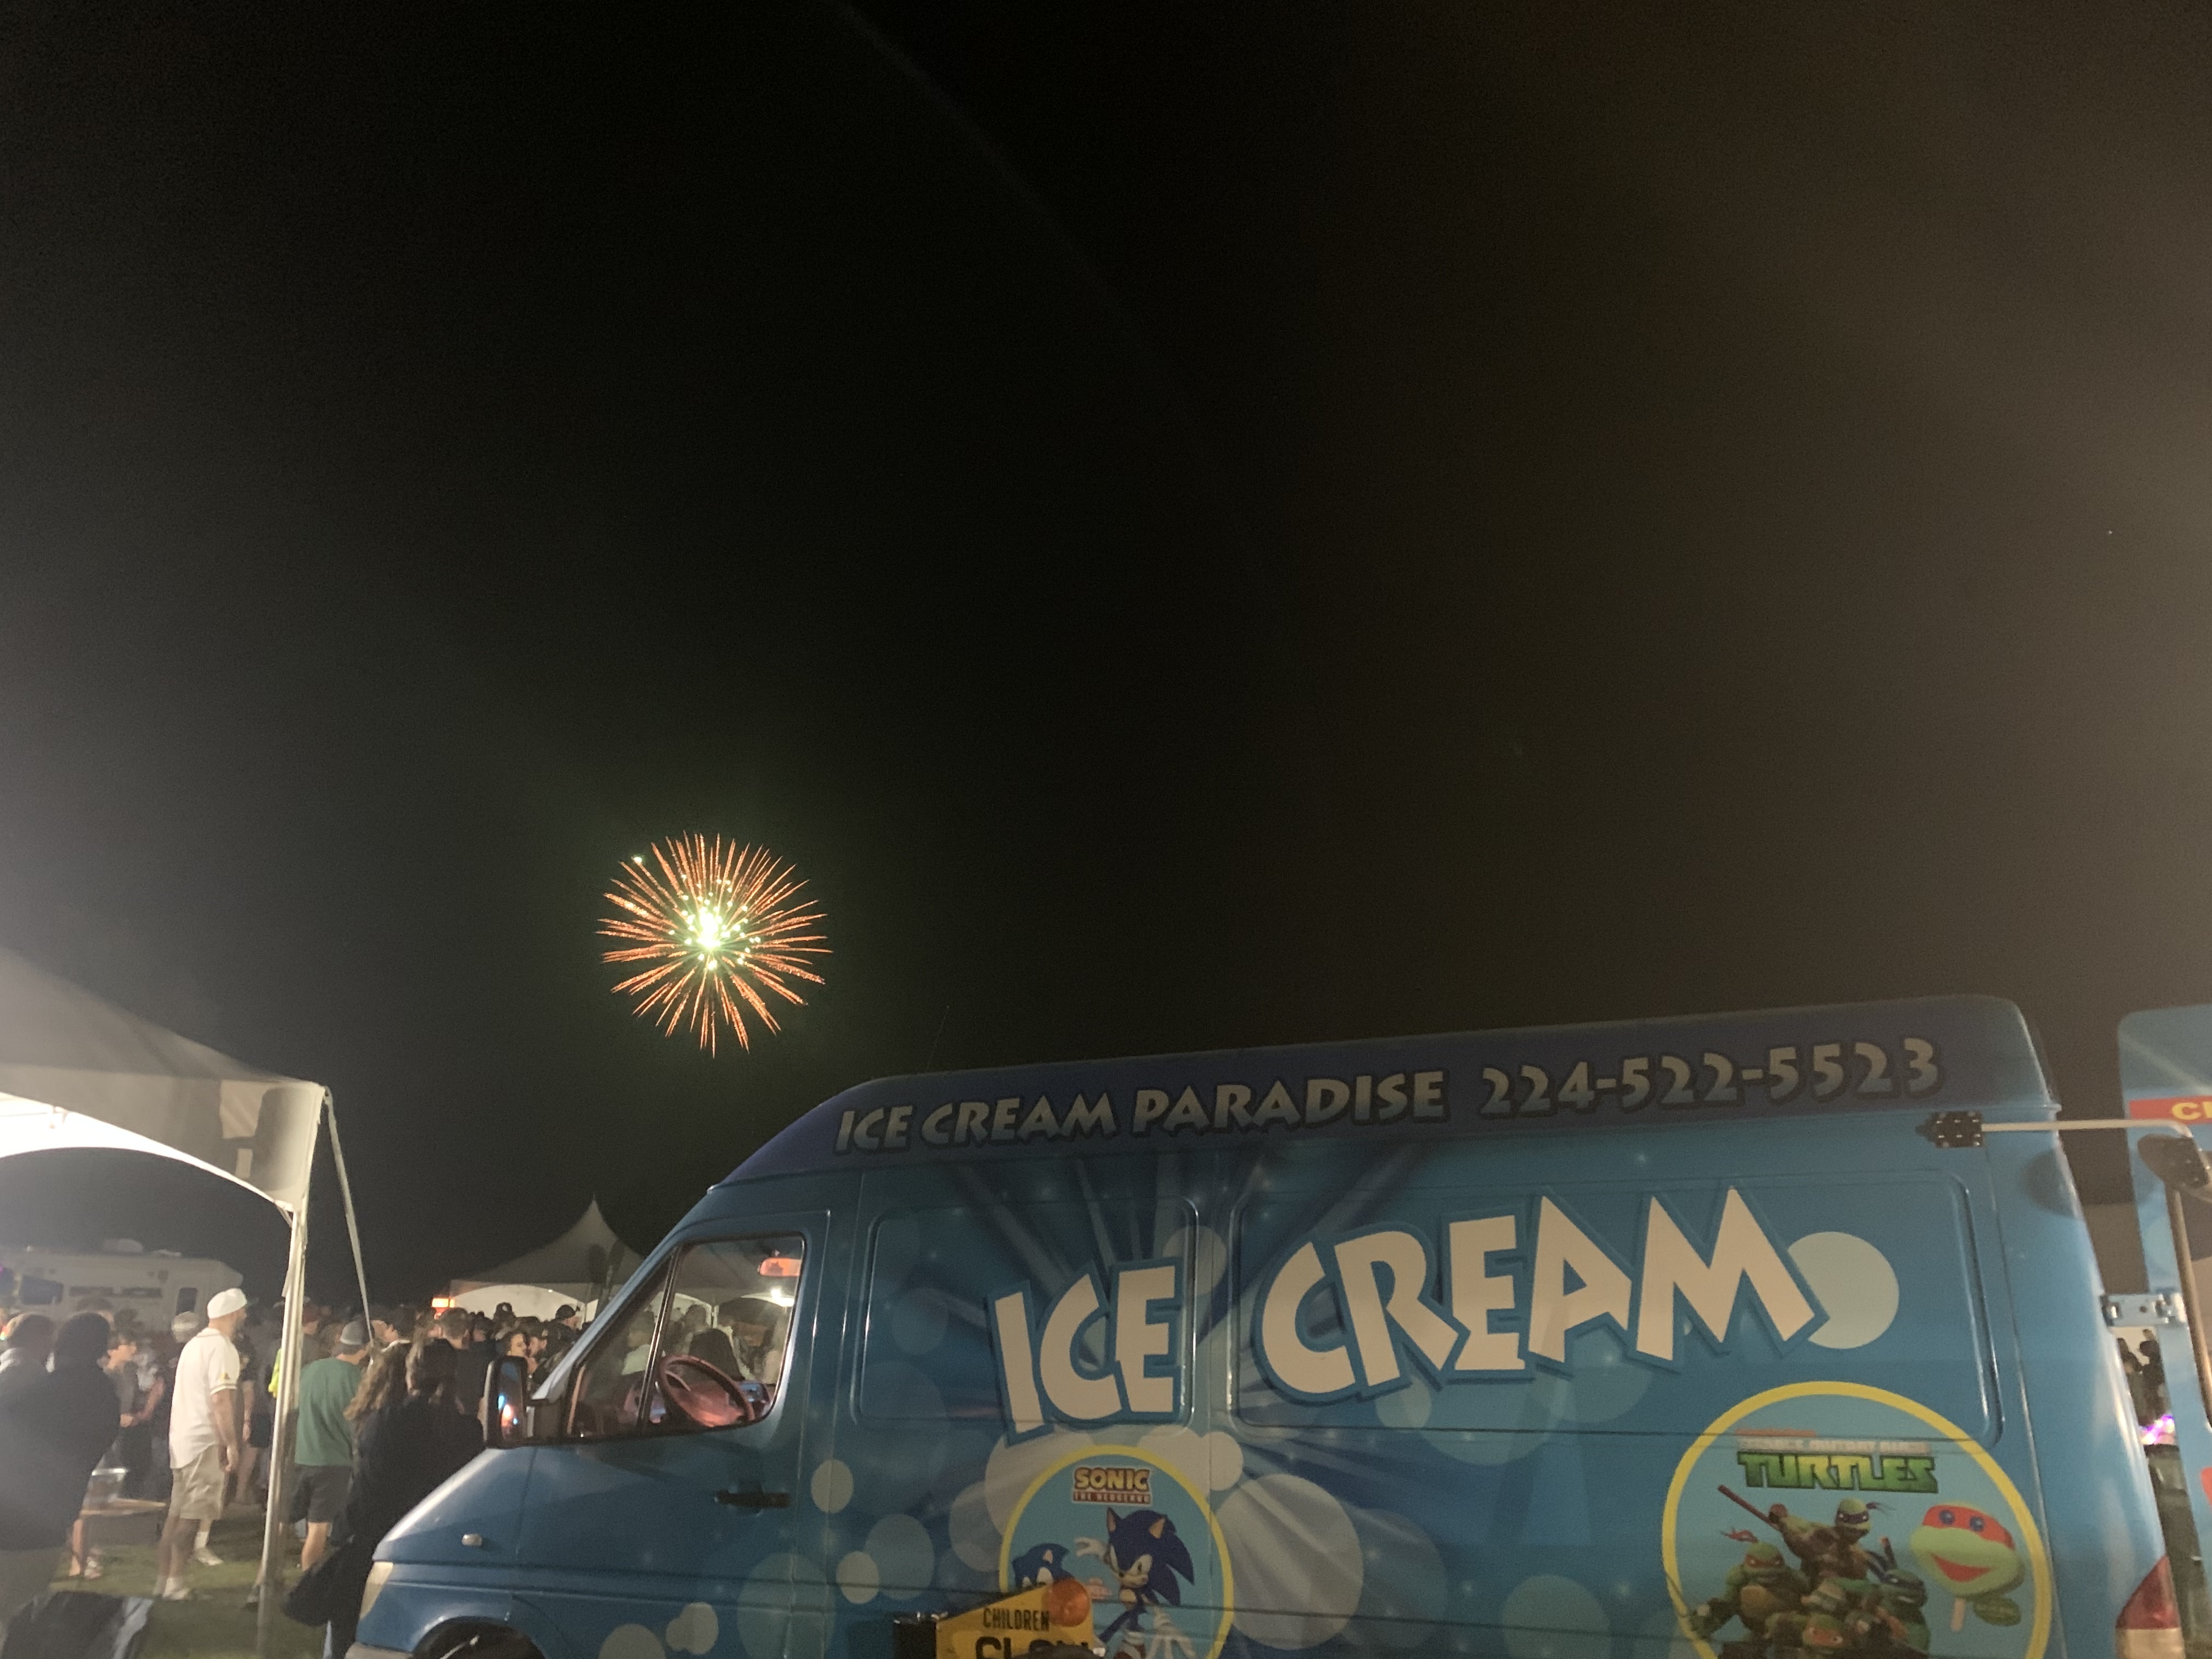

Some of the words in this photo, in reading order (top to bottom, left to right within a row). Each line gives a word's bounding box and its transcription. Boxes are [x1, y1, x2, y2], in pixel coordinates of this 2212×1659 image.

[835, 1107, 913, 1151] ICE
[921, 1093, 1117, 1144] CREAM
[1132, 1071, 1445, 1132] PARADISE
[1481, 1037, 1938, 1114] 224-522-5523
[994, 1265, 1177, 1434] ICE
[1261, 1185, 1814, 1395] CREAM
[1074, 1467, 1150, 1491] SONIC
[1737, 1451, 1939, 1493] TURTLES
[983, 1607, 1049, 1632] CHILDREN
